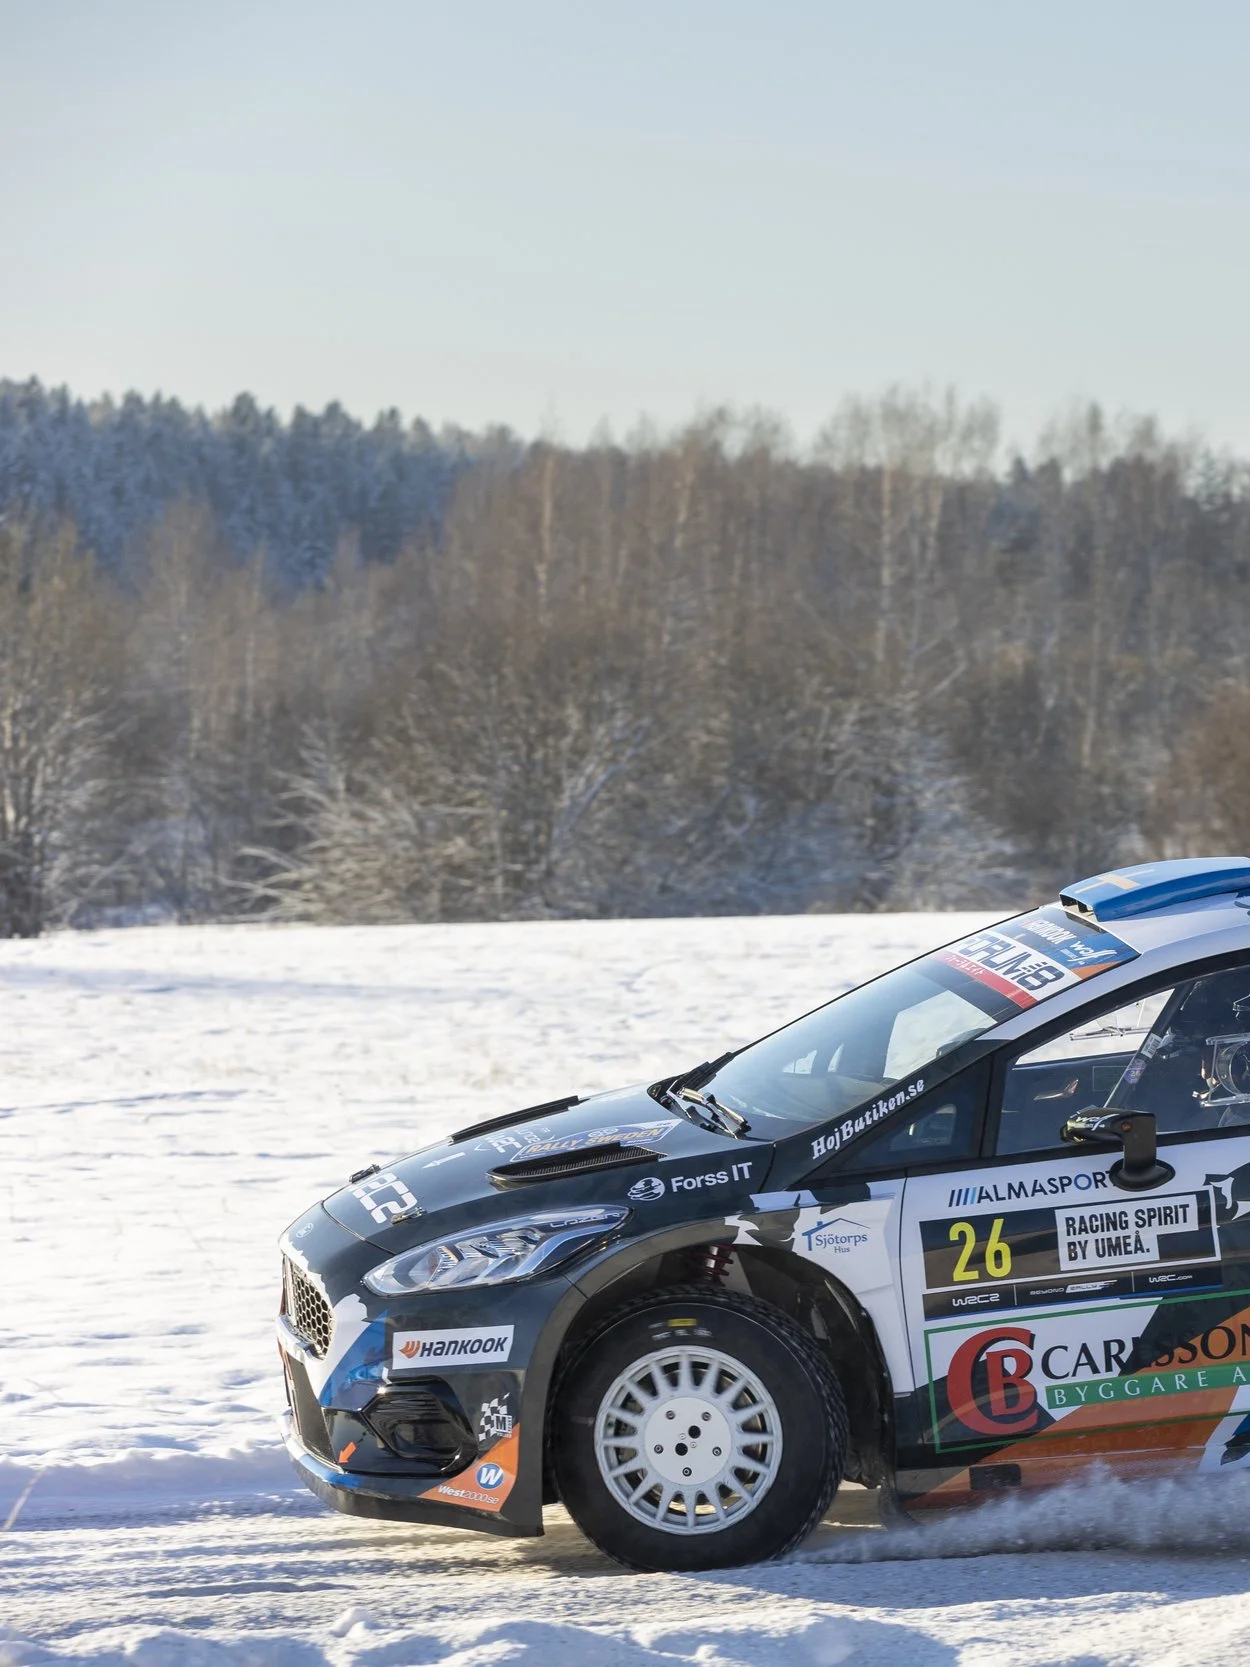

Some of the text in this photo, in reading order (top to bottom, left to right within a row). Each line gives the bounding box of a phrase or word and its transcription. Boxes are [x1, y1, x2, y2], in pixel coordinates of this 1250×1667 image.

[811, 1079, 924, 1159] HojButiken.se
[671, 1162, 752, 1192] Forss IT
[976, 1170, 1118, 1204] ALMASPOR
[1065, 1203, 1190, 1236] RACING SPIRIT
[815, 1232, 868, 1250] Sjötorps
[834, 1245, 850, 1254] Hus
[949, 1219, 1012, 1282] 26
[1067, 1240, 1088, 1261] BY
[952, 1293, 1000, 1307] WRC2
[1054, 1371, 1208, 1405] BYGGARE
